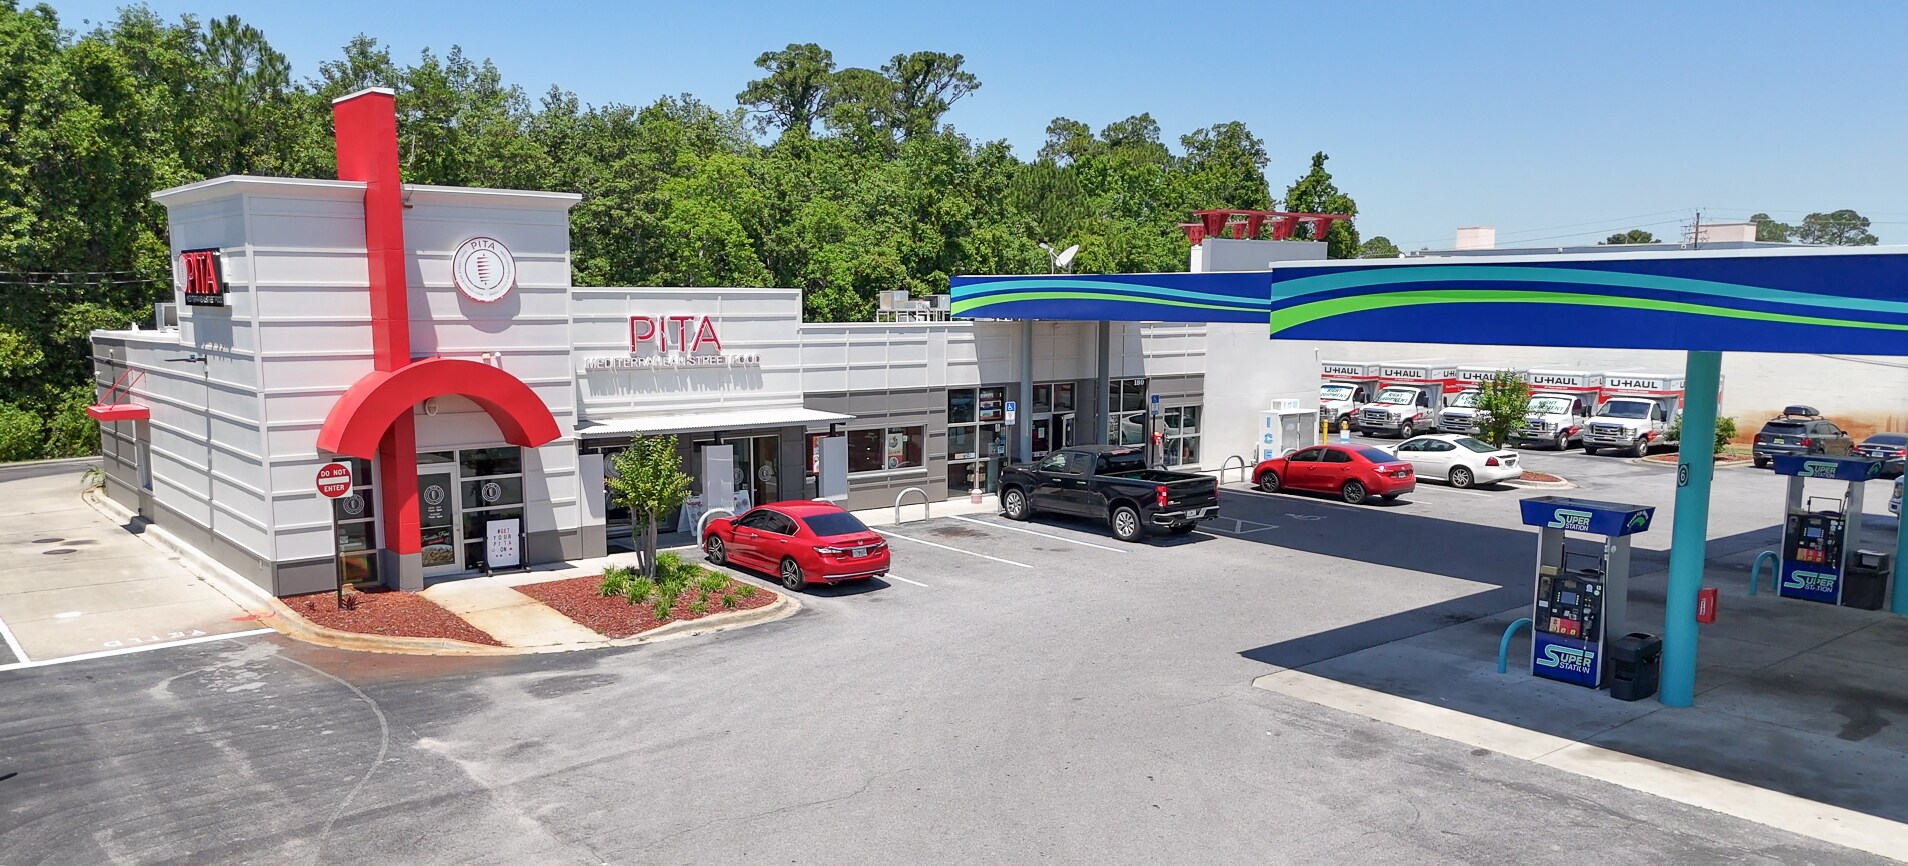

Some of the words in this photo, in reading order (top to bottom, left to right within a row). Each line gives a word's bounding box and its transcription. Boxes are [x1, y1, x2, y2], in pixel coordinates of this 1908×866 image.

[471, 240, 495, 250] PITA
[183, 251, 218, 294] PITA
[629, 315, 722, 353] PITA
[586, 354, 686, 368] MEDITERRANEAN
[687, 354, 729, 366] STREET
[730, 354, 761, 365] FOOD
[1324, 366, 1359, 375] U-HAUL
[1385, 369, 1421, 378] U-HAUL
[1534, 376, 1577, 385] U-HAUL
[1610, 379, 1658, 389] U-HAUL
[1264, 416, 1273, 460] ICE
[333, 468, 346, 476] NOT
[1797, 460, 1838, 477] SUPER
[324, 484, 345, 492] ENTER
[1548, 508, 1592, 529] SUPER
[1565, 523, 1589, 531] STATION
[1783, 569, 1837, 589] SUPER
[1536, 643, 1595, 668] SUPER
